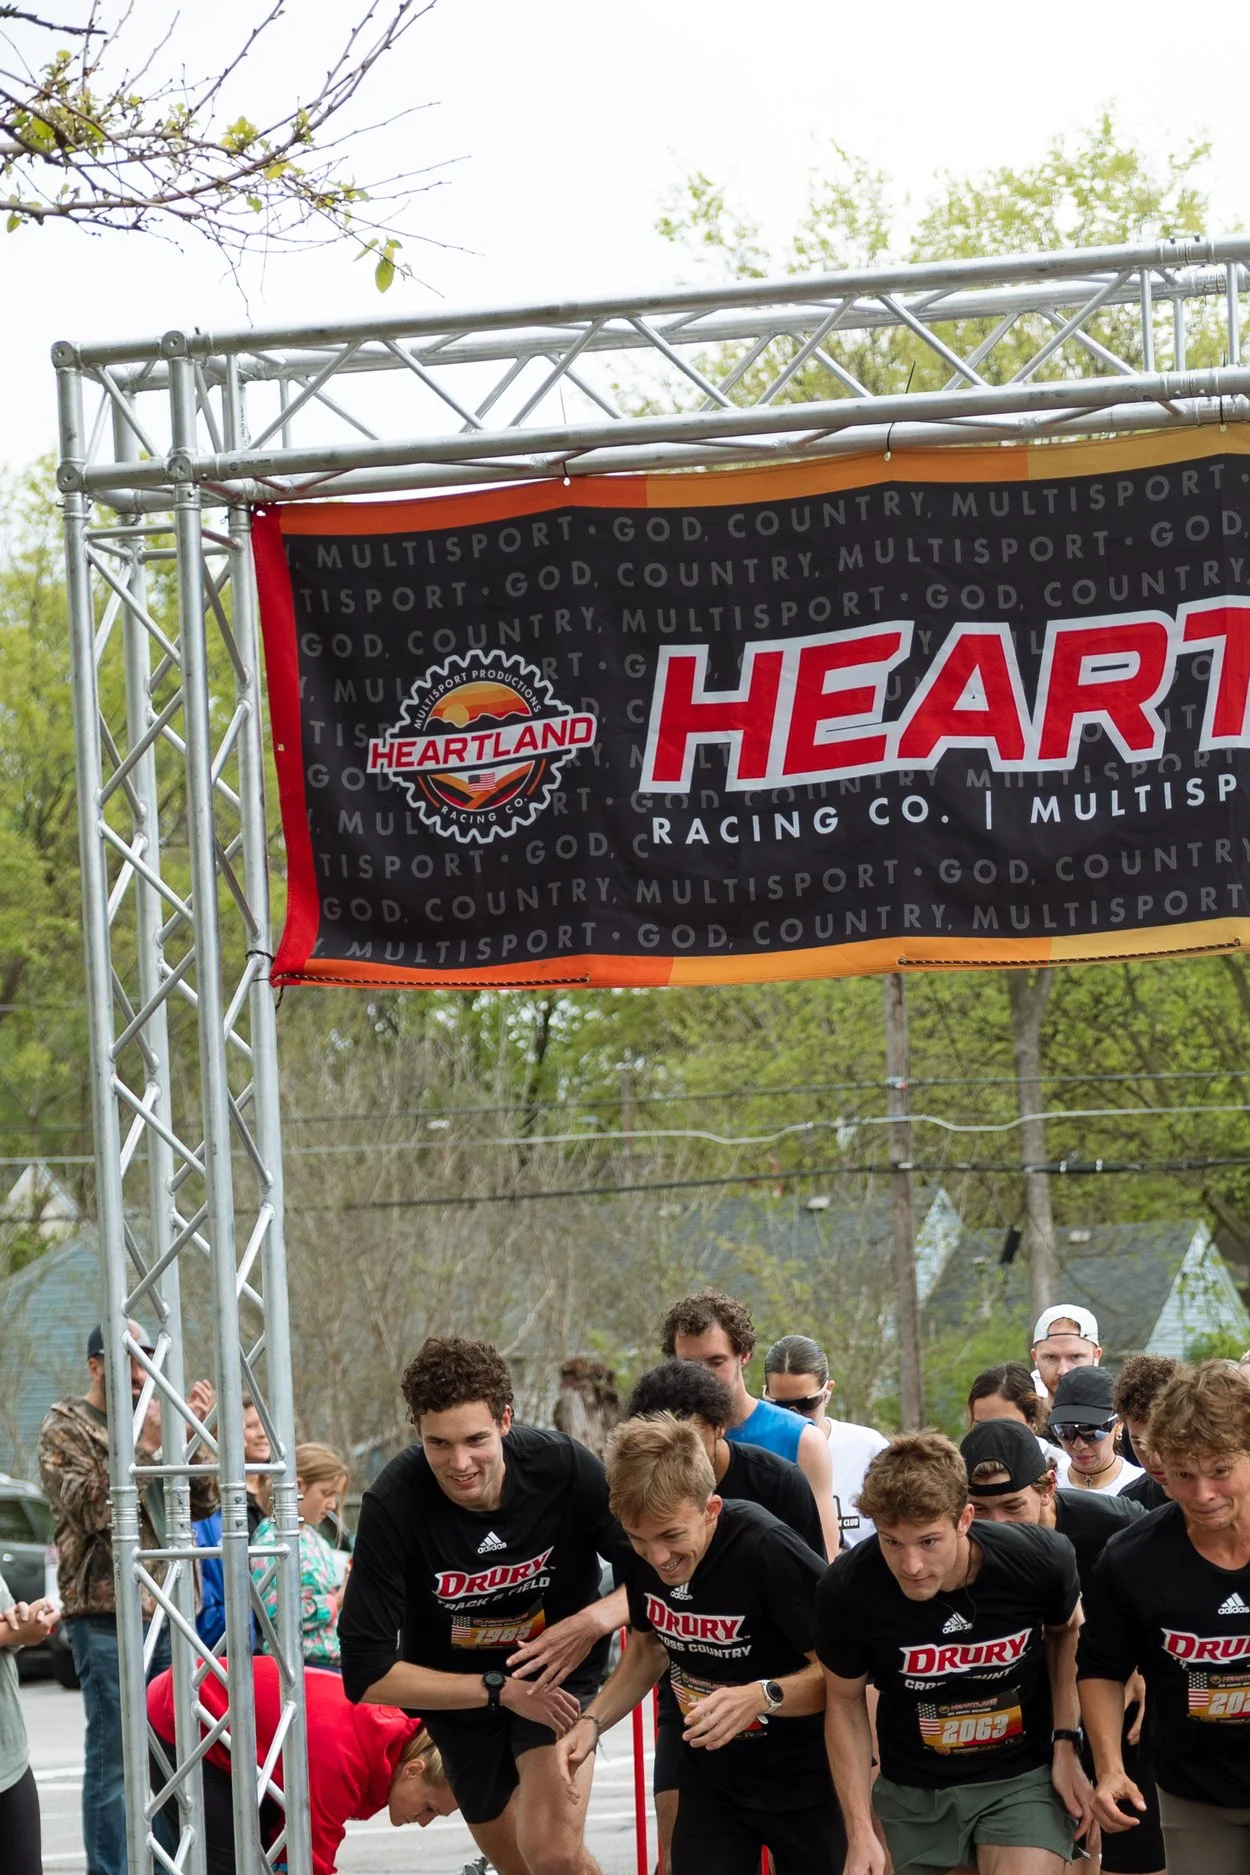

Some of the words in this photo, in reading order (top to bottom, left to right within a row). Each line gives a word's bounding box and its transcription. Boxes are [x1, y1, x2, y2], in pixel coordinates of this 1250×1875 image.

[317, 516, 573, 569] MULTISPORT
[728, 490, 932, 540] COUNTRY,
[951, 463, 1227, 518] MULTISPORT
[505, 560, 599, 598] GOD,
[617, 552, 822, 588] COUNTRY,
[838, 530, 1109, 572] MULTISPORT
[1150, 509, 1249, 548] GOD,
[407, 605, 604, 656] COUNTRY,
[622, 585, 884, 634] MULTISPORT
[926, 583, 1025, 612] GOD,
[414, 672, 468, 730] MULTISPORT
[471, 669, 542, 713] PRODUCTIONS
[369, 714, 595, 772] HEARTLAND
[441, 805, 497, 824] RACING
[506, 797, 528, 814] CO.
[652, 806, 839, 845] RACING
[869, 794, 950, 826] CO.
[425, 876, 617, 920] COUNTRY,
[636, 859, 900, 904] MULTISPORT
[939, 859, 1036, 887] GOD,
[350, 922, 597, 963] MULTISPORT
[637, 923, 734, 950] GOD,
[753, 904, 953, 946] COUNTRY,
[972, 884, 1244, 930] MULTISPORT
[432, 1546, 554, 1599] DRURY
[477, 1542, 507, 1554] adidas
[508, 1577, 551, 1596] FIELD
[670, 1590, 693, 1600] adidas
[1218, 1605, 1250, 1615] adidas
[474, 1620, 534, 1644] 1985
[643, 1593, 746, 1645] DRURY
[942, 1622, 973, 1634] adidas
[688, 1643, 752, 1659] COUNTRY
[898, 1627, 1033, 1678] DRURY
[941, 1714, 1009, 1744] 2063
